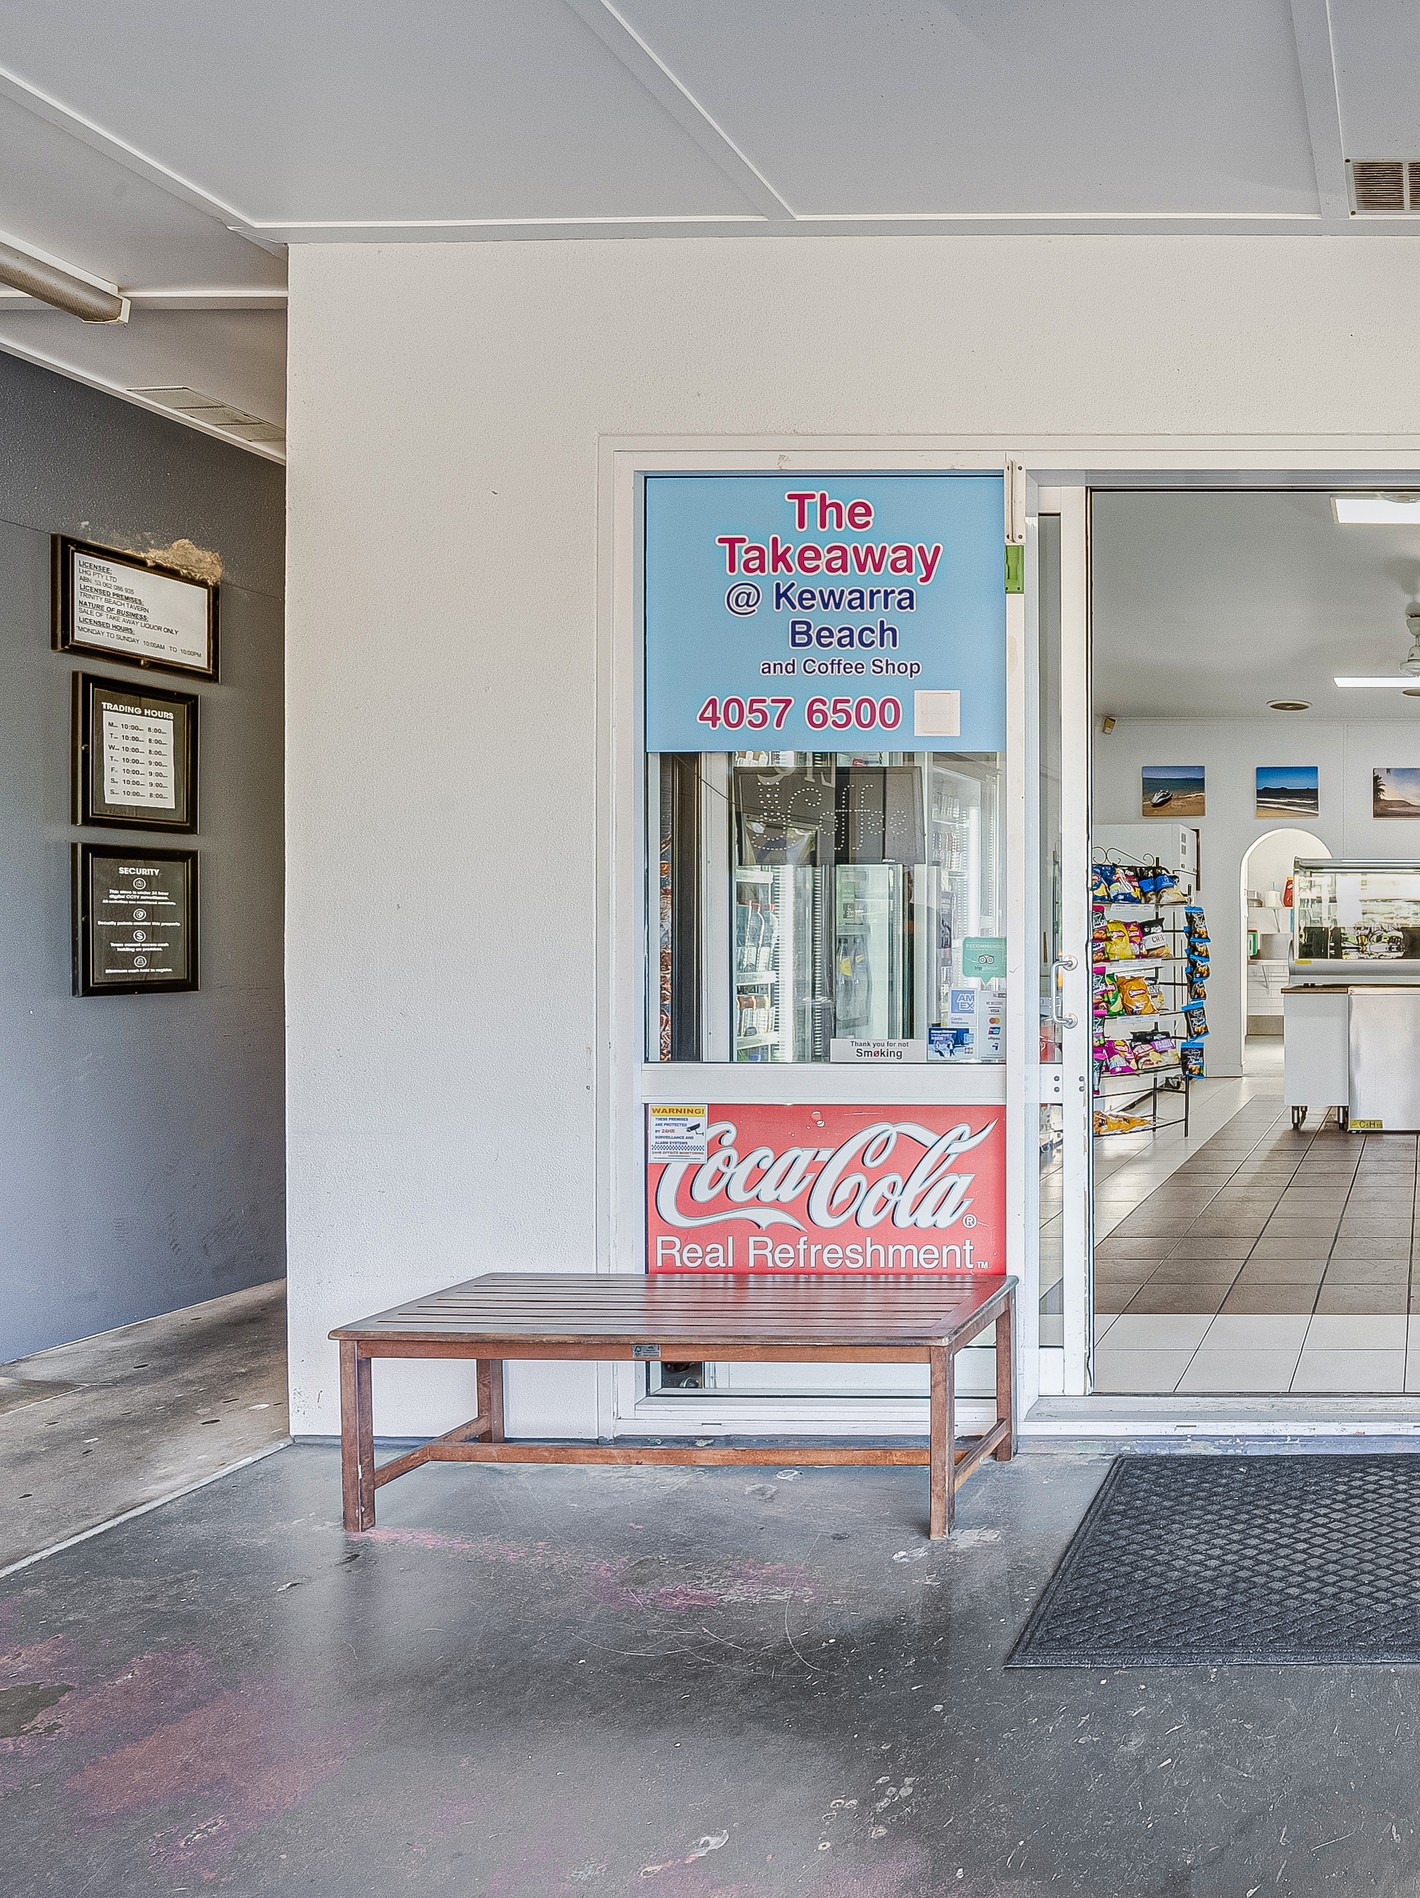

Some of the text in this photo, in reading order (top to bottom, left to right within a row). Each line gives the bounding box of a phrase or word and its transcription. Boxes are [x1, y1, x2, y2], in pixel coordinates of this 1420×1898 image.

[787, 492, 873, 530] The
[79, 560, 112, 575] LICENSEE:
[717, 536, 942, 583] Takeaway
[79, 568, 117, 583] LHG PTY LTD
[79, 584, 112, 597] LICENSED
[726, 582, 916, 616] @ Kewarra
[79, 592, 150, 614] TRINITY BEACH TAVERN
[79, 600, 105, 612] NATURE
[106, 606, 116, 614] OF
[79, 607, 95, 617] SALE
[105, 614, 121, 623] TAKE
[122, 617, 141, 627] AWAY
[140, 621, 163, 632] LIQUOR
[163, 627, 180, 636] ONLY
[79, 616, 111, 629] LICENSED
[116, 634, 141, 645] SUNDAY
[790, 620, 898, 649] Beach
[761, 659, 921, 678] and Coffee Shop
[101, 702, 174, 720] TRADING HOURS
[698, 697, 902, 730] 4057 6500
[786, 784, 907, 850] Coffee
[118, 867, 160, 876] SECURITY
[656, 1118, 998, 1232] Coca-Cola
[656, 1236, 733, 1268] Real
[749, 1236, 975, 1270] Refreshment
